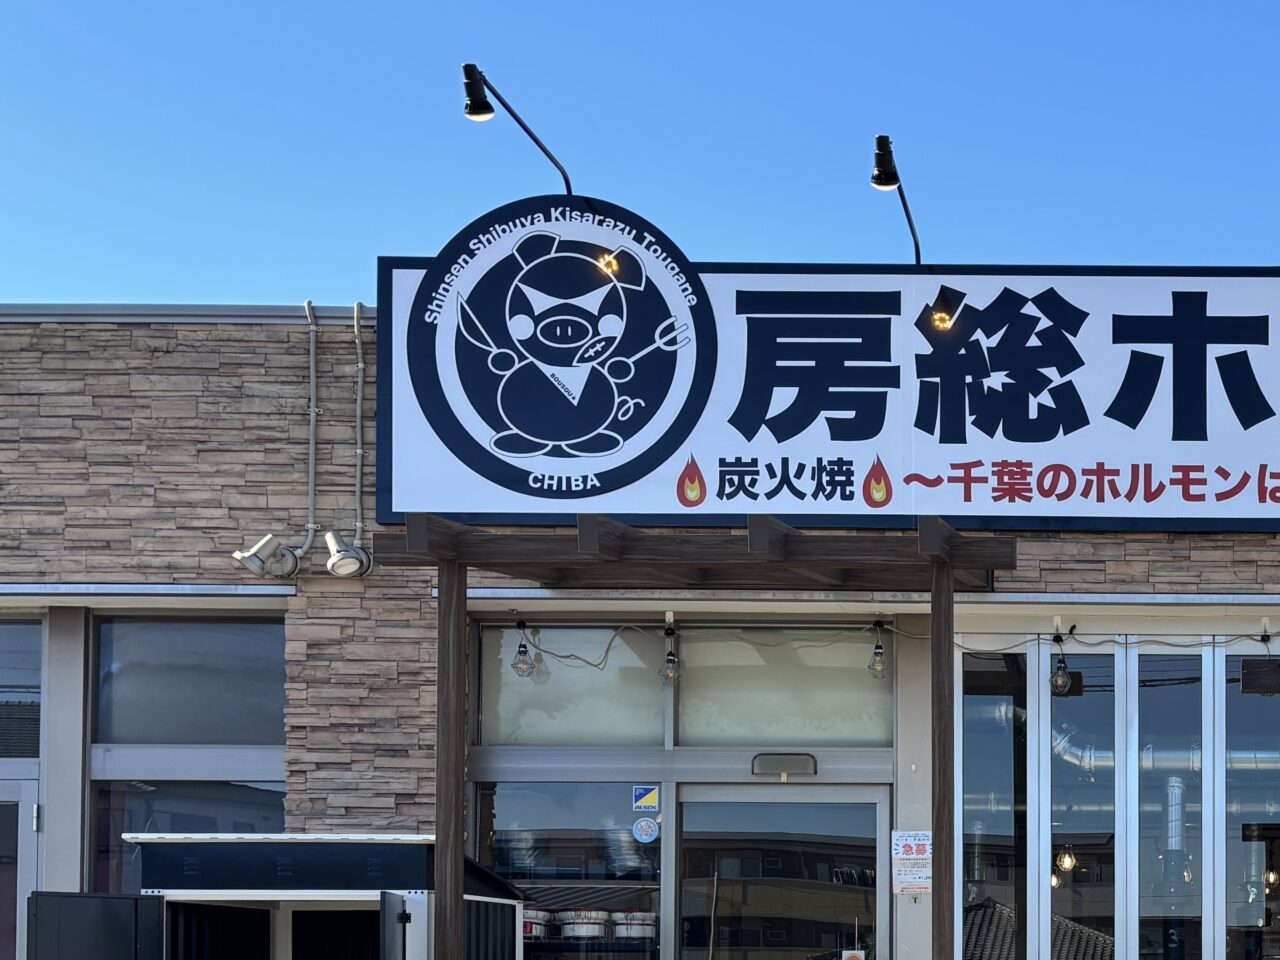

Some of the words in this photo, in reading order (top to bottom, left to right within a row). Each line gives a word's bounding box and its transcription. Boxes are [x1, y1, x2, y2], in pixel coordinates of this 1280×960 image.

[424, 253, 474, 326] Shinsen
[468, 211, 546, 255] Shibuya
[550, 206, 638, 239] Kisarazu
[640, 231, 698, 308] Tougane
[528, 472, 601, 491] CHIBA
[715, 456, 855, 502] 炭火焼
